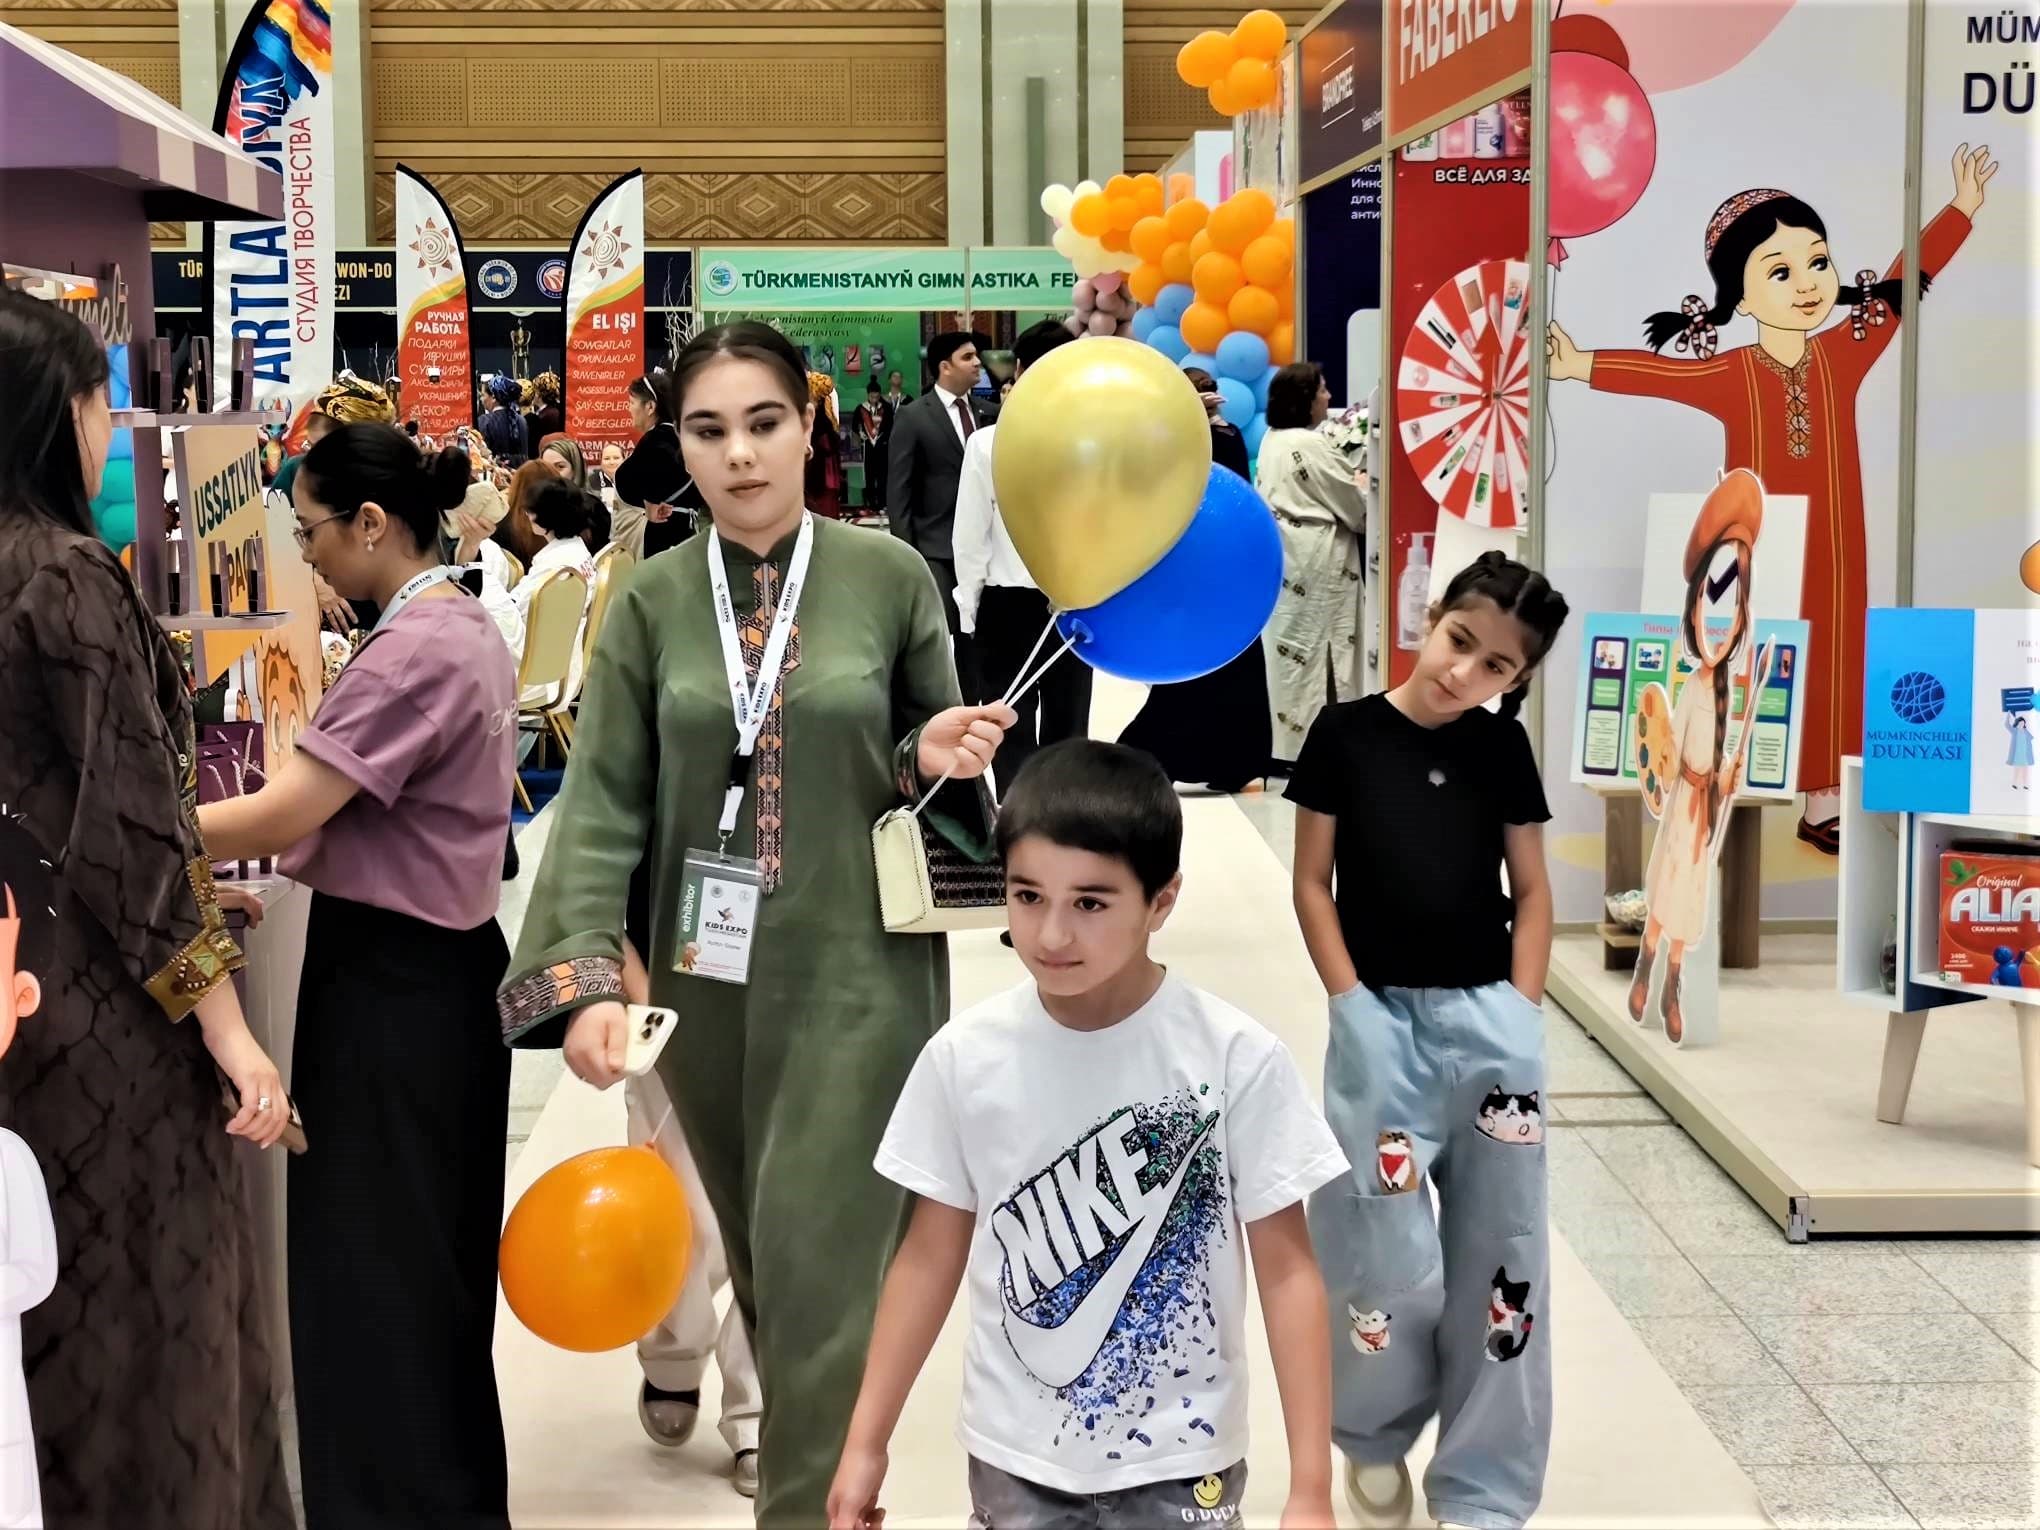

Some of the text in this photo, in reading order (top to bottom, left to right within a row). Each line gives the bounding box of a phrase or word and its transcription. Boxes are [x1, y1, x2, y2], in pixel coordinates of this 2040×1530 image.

[1967, 10, 2040, 43] MÜM
[1963, 61, 2036, 114] DÜ
[1435, 166, 1467, 182] ВСЁ
[1472, 169, 1507, 184] ДЛЯ
[1351, 195, 1374, 205] для
[289, 117, 319, 343] СТУДИЯ ТВОРЧЕСТВА
[336, 262, 392, 278] WON-DO
[742, 269, 913, 289] TÜRKMENISTANYŇ
[428, 311, 465, 322] РУЧНАЯ
[592, 312, 636, 335] EL IŞI
[415, 322, 461, 334] РАБОТА
[408, 338, 457, 349] ПОДАРКИ
[573, 340, 632, 351] SOWGATLAR
[573, 370, 626, 380] SUWENIRLER
[195, 447, 260, 538] USSATLYK
[1867, 731, 1968, 743] MUMKINCHILIK
[1872, 744, 1962, 761] DUNYASI
[1976, 874, 2023, 891] Original
[682, 883, 696, 933] exhibitor
[1950, 887, 2040, 922] ALIA
[705, 921, 724, 930] KIDS
[726, 925, 748, 935] EXPO
[994, 1108, 1160, 1311] NIKE
